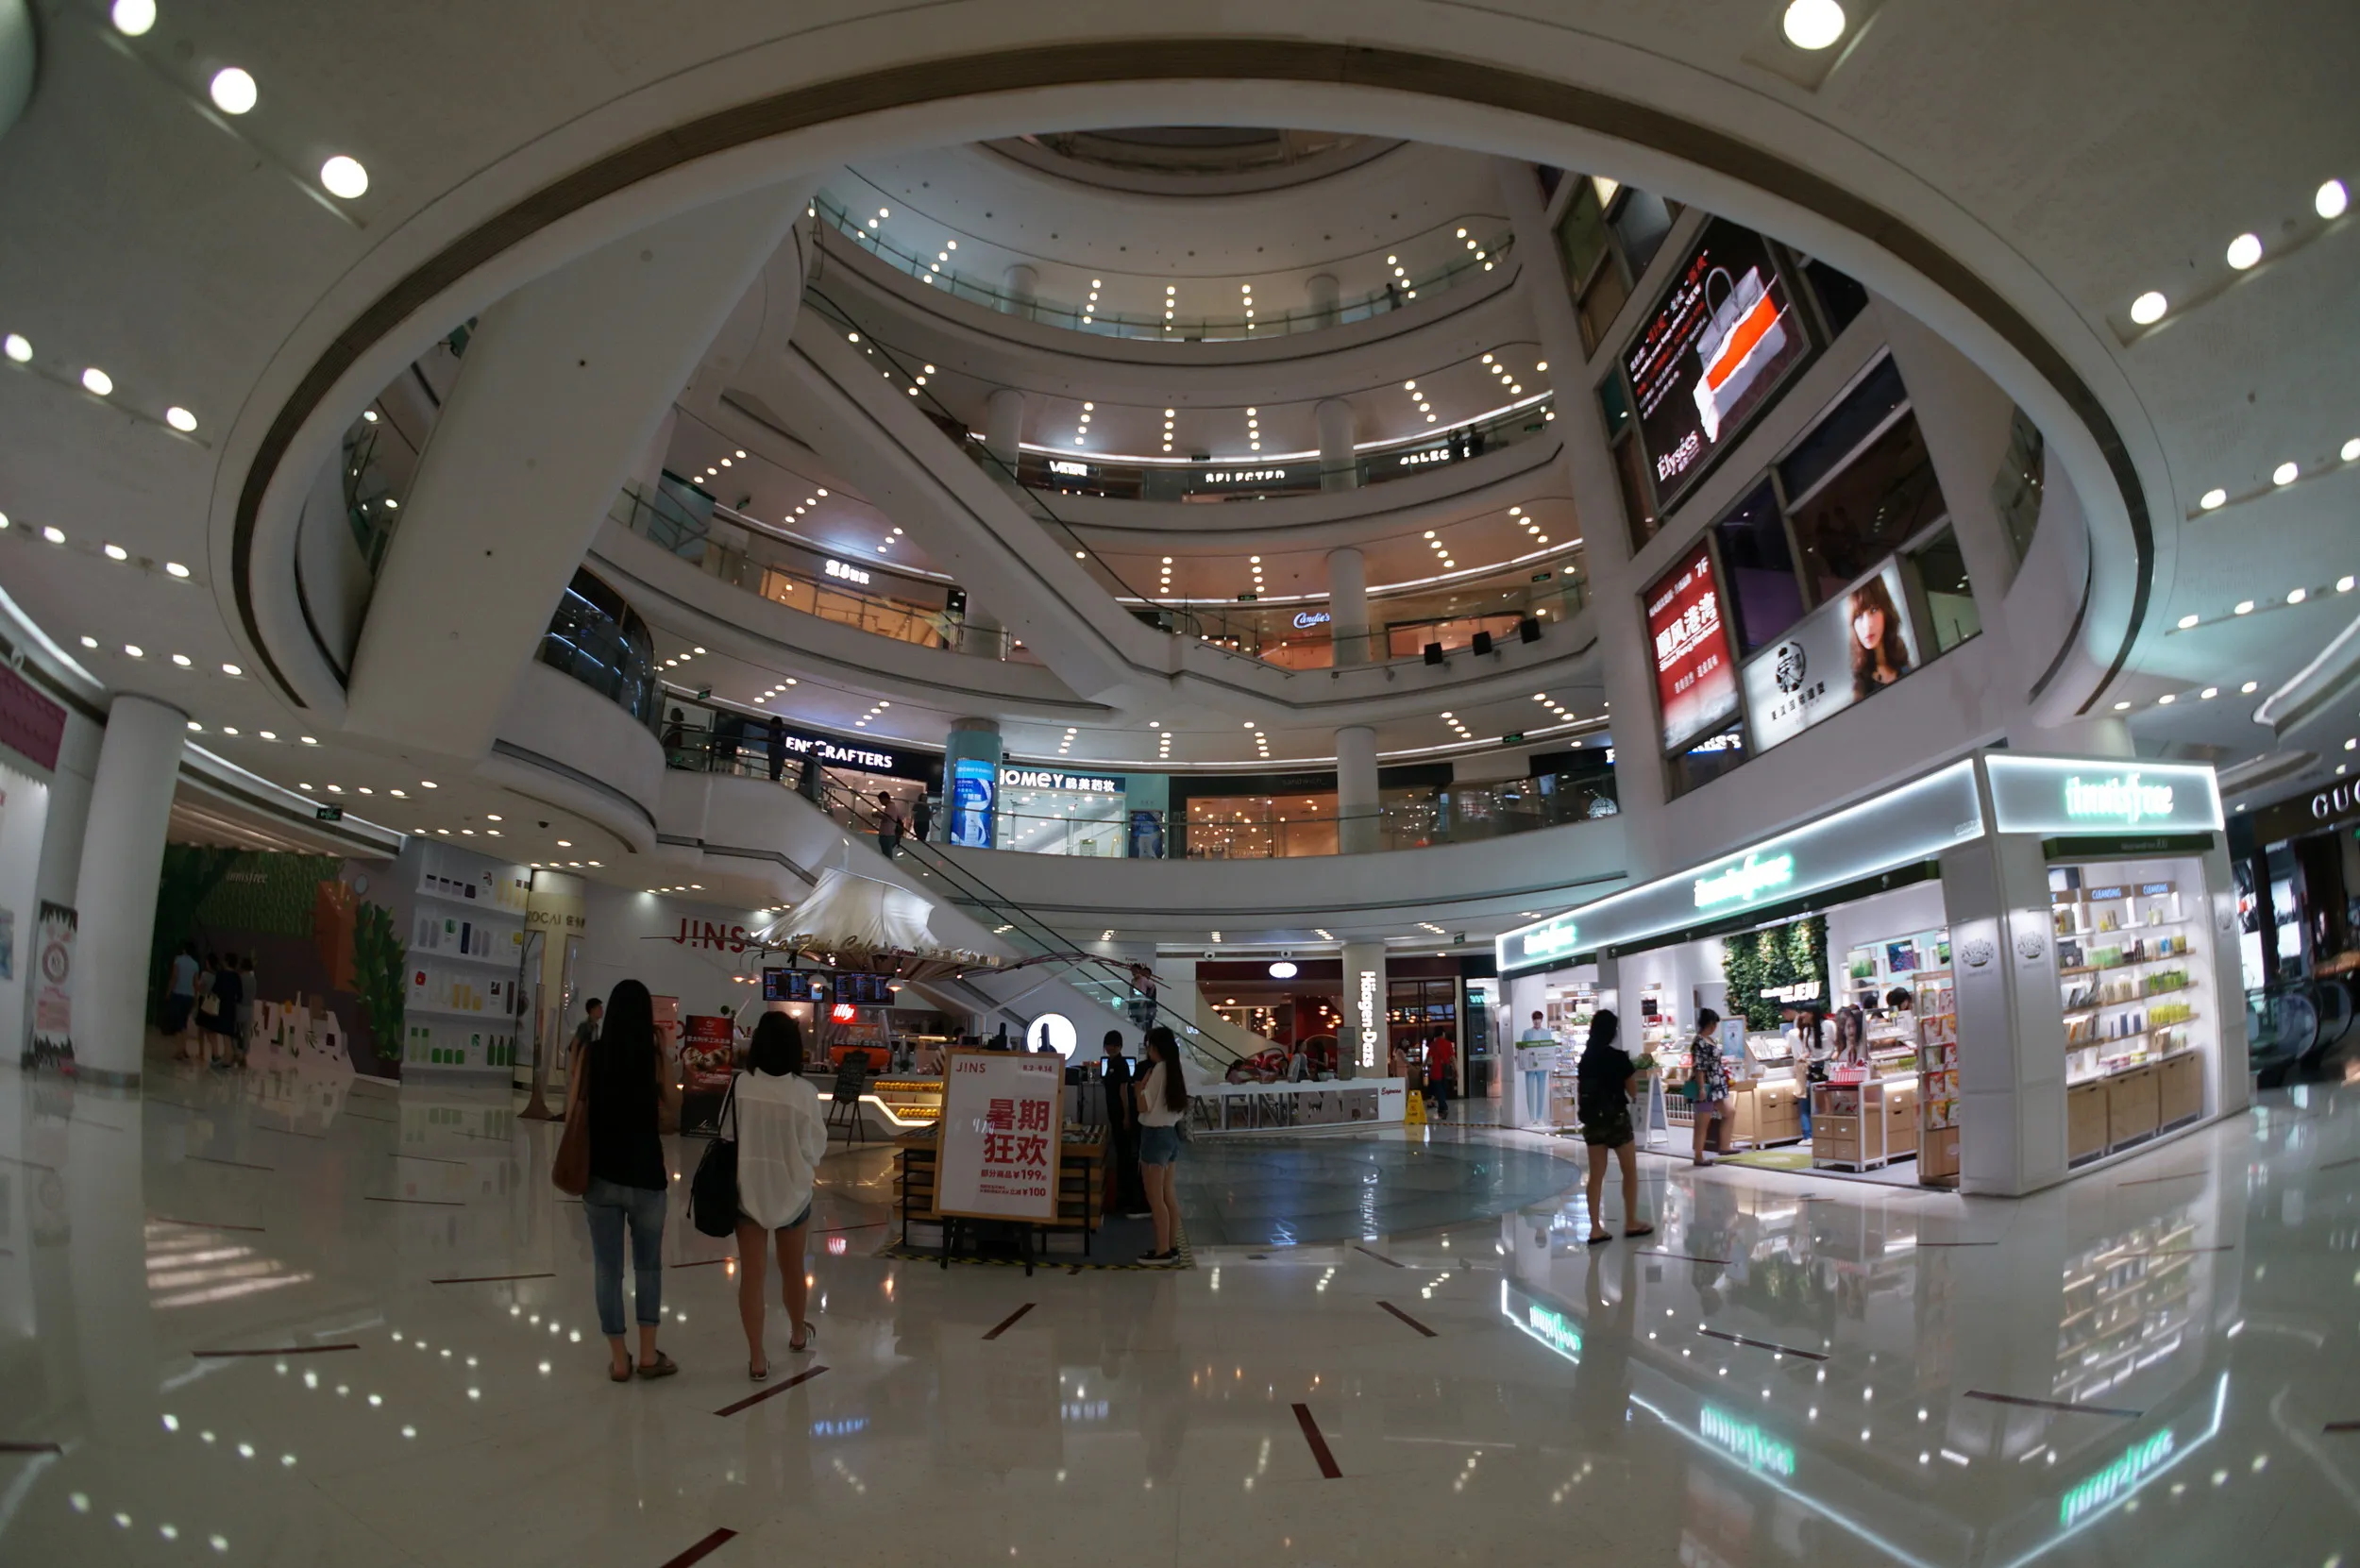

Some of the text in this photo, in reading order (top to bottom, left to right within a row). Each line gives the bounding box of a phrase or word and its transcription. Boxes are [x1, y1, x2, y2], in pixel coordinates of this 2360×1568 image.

[1292, 612, 1331, 630] Candie's
[834, 1003, 854, 1020] illy
[986, 1098, 1051, 1132] 暑期
[983, 1133, 1049, 1167] 狂欢
